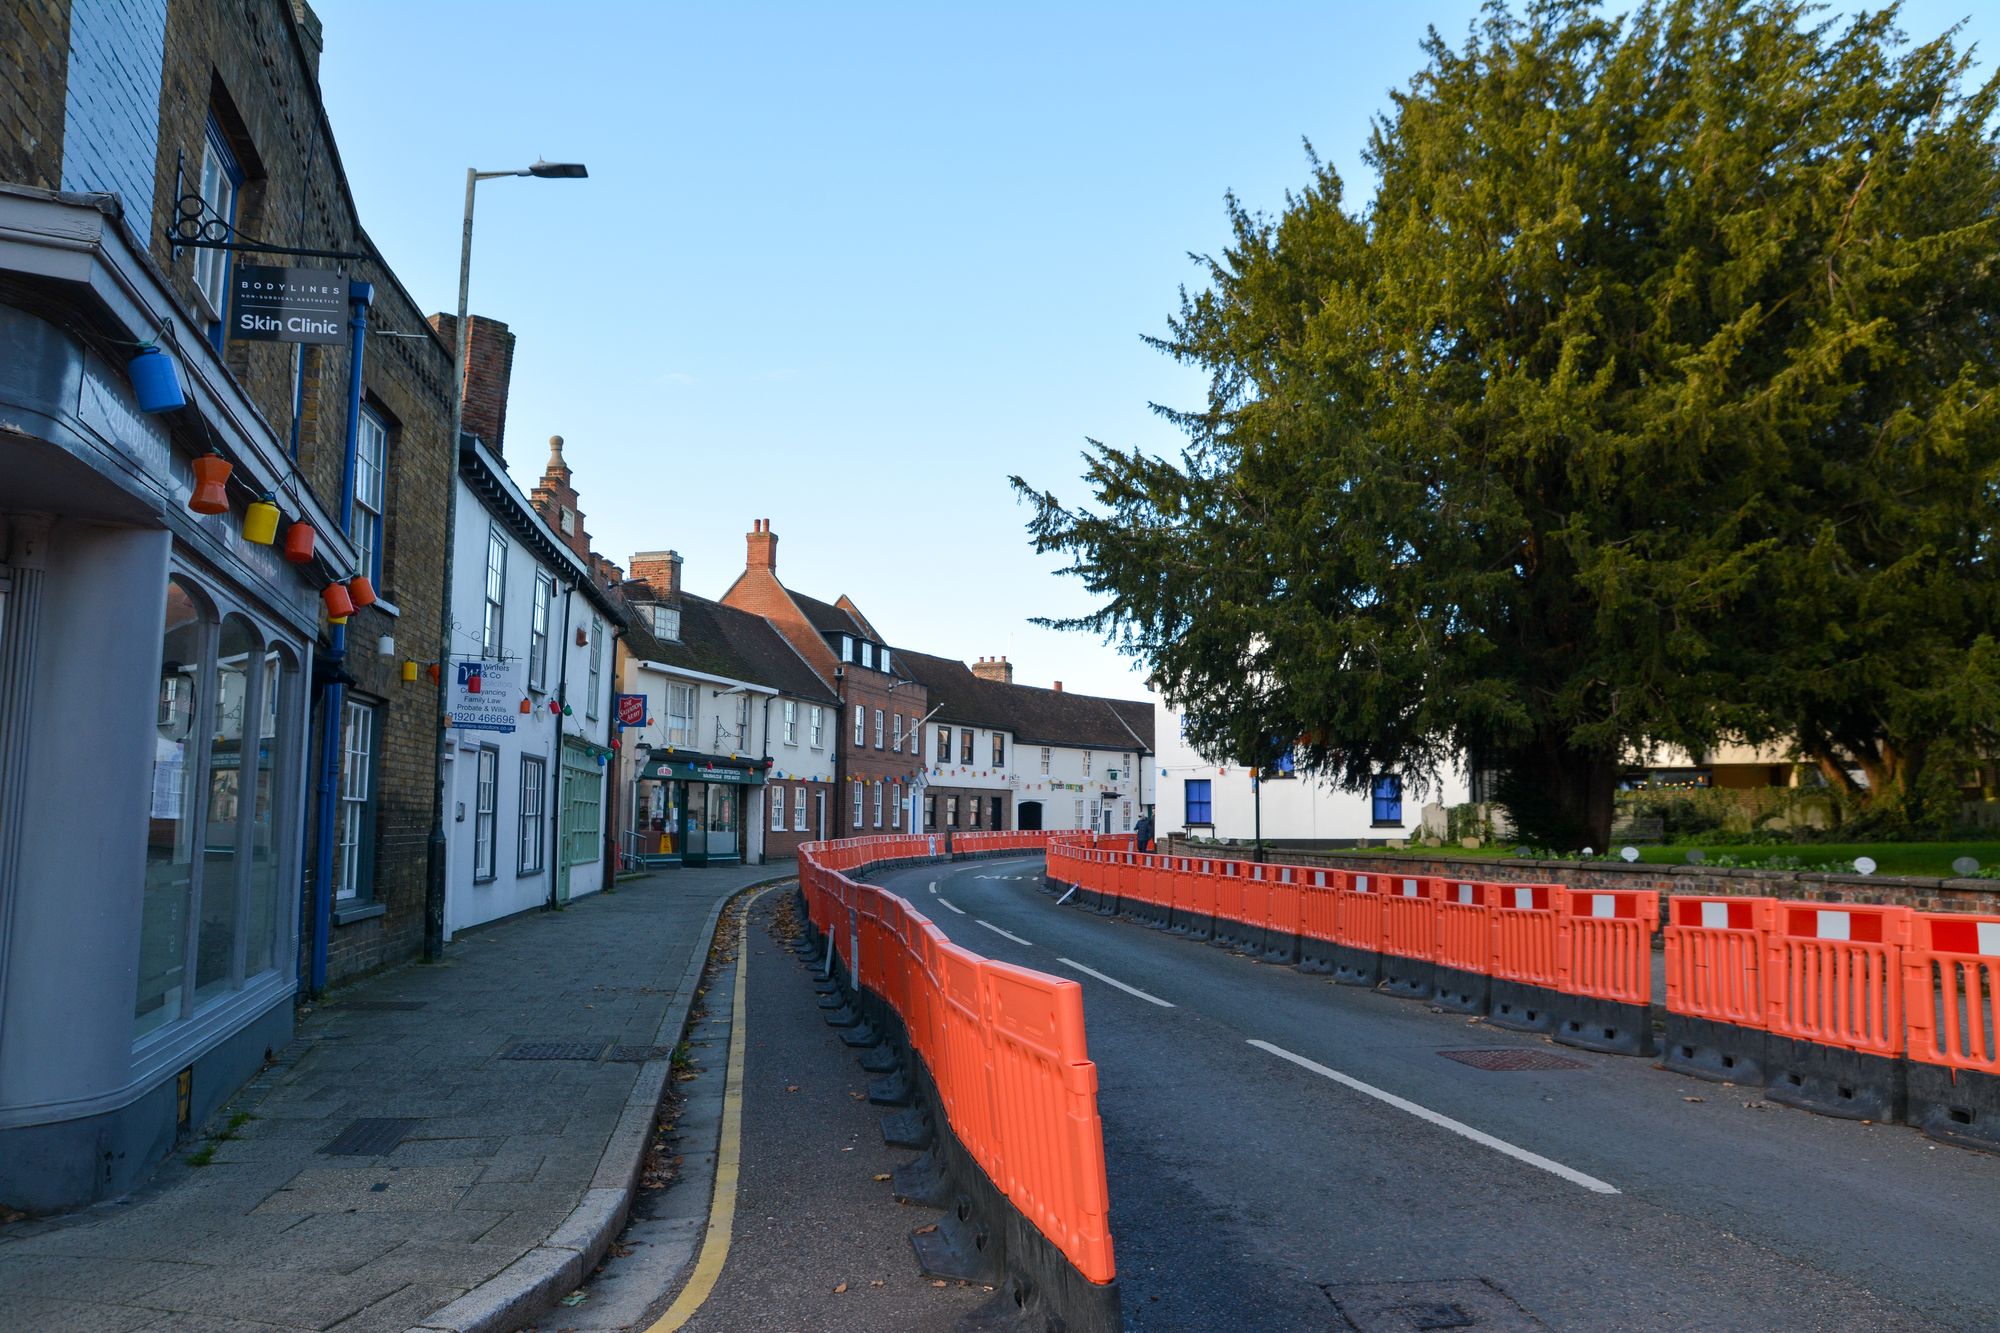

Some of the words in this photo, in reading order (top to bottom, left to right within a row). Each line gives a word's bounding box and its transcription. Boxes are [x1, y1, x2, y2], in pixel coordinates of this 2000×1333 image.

[241, 281, 340, 295] BODYLINES
[240, 314, 283, 331] Skin
[287, 317, 338, 335] Clinic
[484, 663, 510, 672] Winters
[464, 696, 485, 705] Family
[457, 704, 483, 712] Probate
[478, 714, 515, 725] 466696
